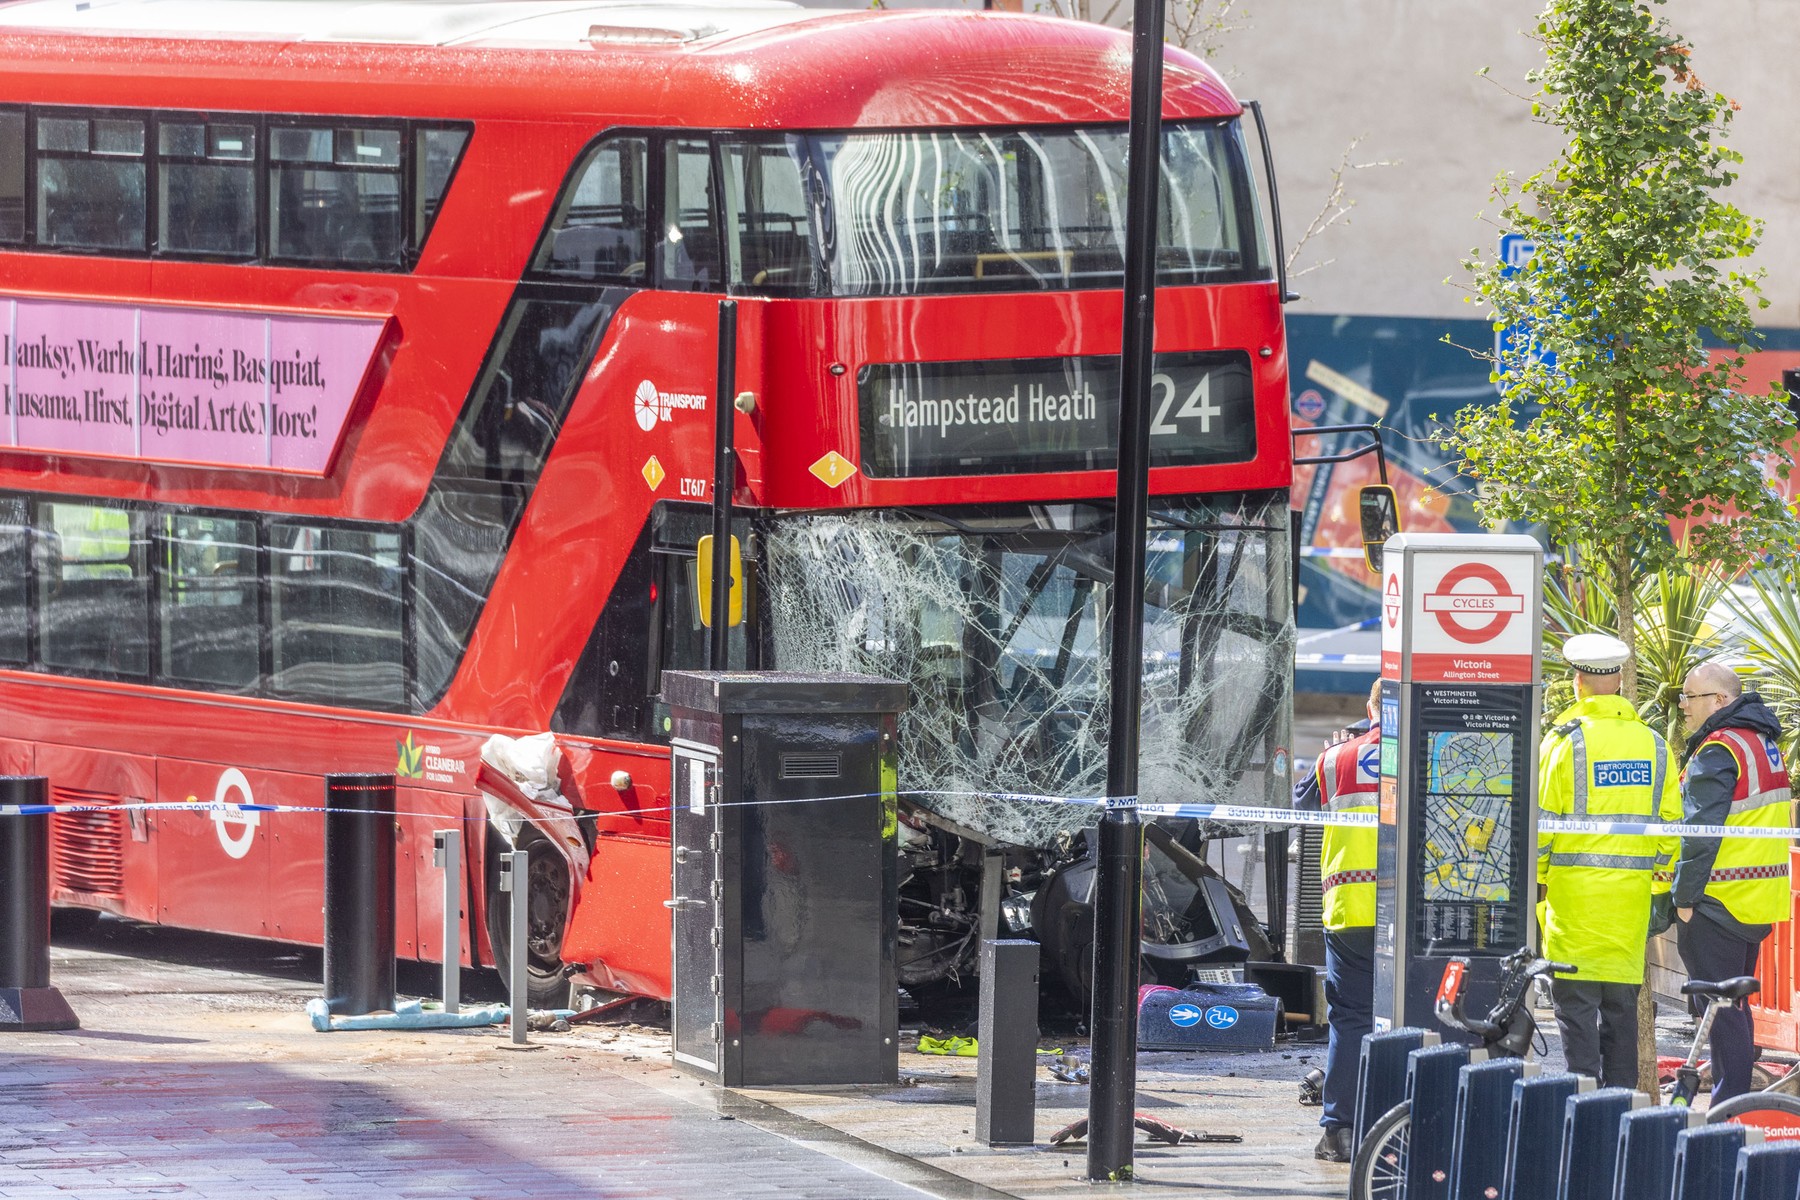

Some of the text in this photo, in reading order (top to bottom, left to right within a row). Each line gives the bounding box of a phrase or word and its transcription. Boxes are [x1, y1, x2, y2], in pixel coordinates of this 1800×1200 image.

[77, 339, 153, 380] Warhol,
[157, 343, 229, 390] Haring,
[232, 349, 326, 394] Basquiat,
[659, 392, 707, 410] TRANSPORT
[1150, 372, 1221, 435] 24
[84, 387, 133, 429] Hirst,
[138, 391, 200, 437] Digital
[258, 402, 318, 439] More!
[660, 407, 673, 422] UK
[889, 381, 1096, 438] Hampstead Heath
[680, 477, 706, 497] LT617
[1453, 598, 1495, 609] CYCLES
[1453, 660, 1492, 669] Victoria
[1443, 671, 1500, 680] Allington Street
[1460, 697, 1480, 705] Street
[1492, 721, 1510, 729] Place
[1597, 762, 1649, 770] METROPOLITAN
[426, 771, 454, 784] FOR LONDON
[1598, 769, 1650, 784] POLICE
